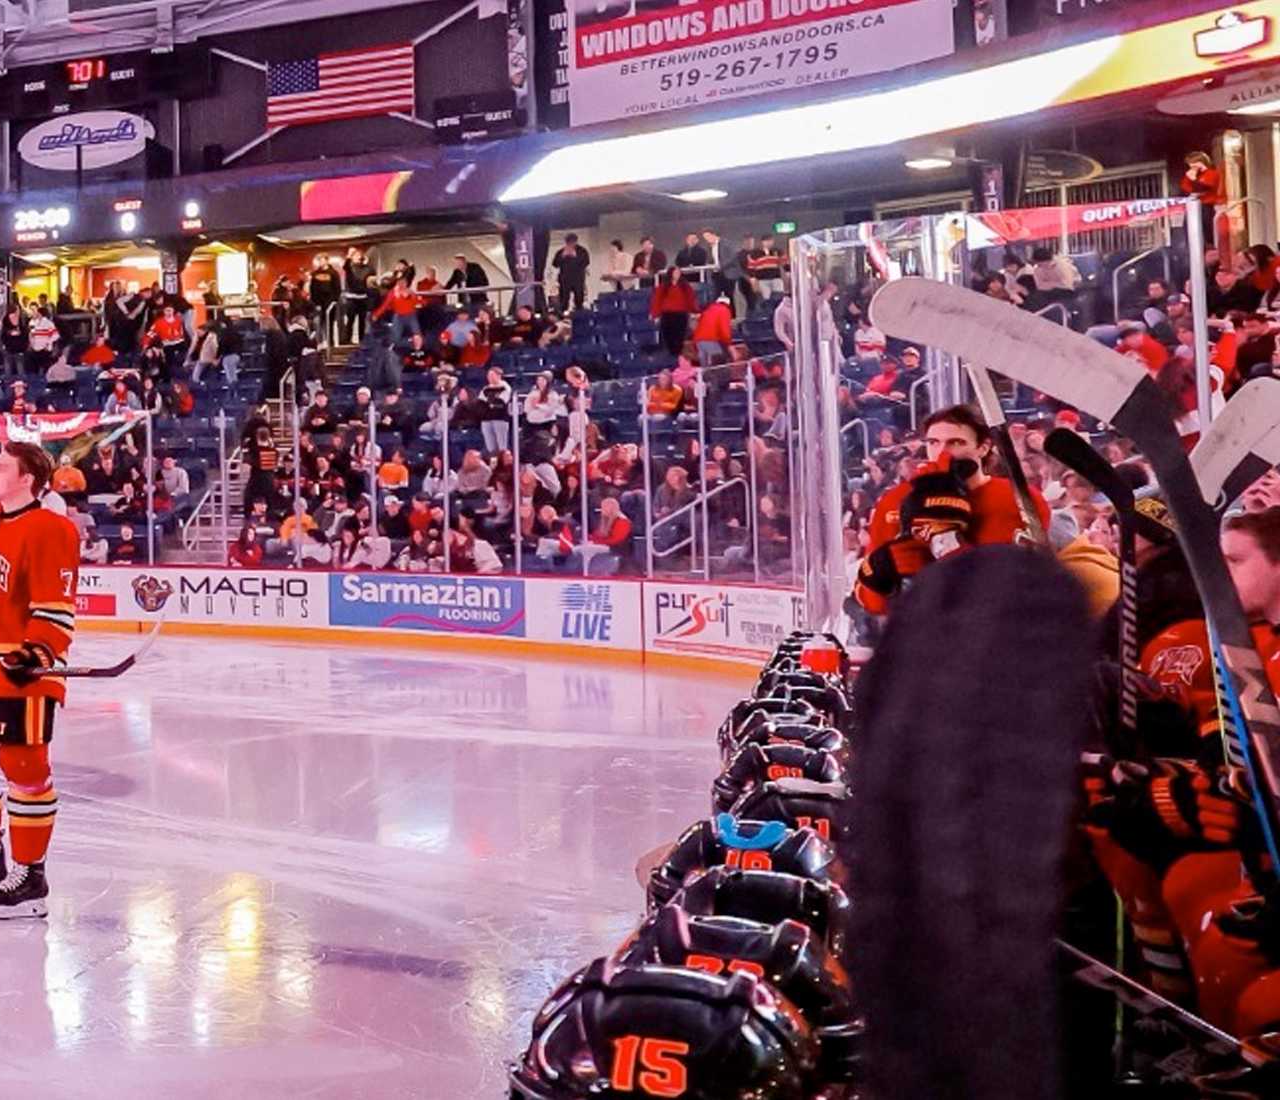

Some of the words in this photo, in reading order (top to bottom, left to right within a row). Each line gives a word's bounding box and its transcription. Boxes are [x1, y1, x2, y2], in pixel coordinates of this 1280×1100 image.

[581, 12, 706, 59] WINDOWS
[712, 0, 766, 34] AND
[620, 13, 885, 76] BETTERWINDOWSANDDOORS.CA
[660, 42, 839, 92] 519-267-1795
[659, 95, 699, 110] LOCAL
[795, 68, 850, 85] DEALER
[59, 568, 73, 597] 7
[180, 575, 308, 598] MACHO
[342, 574, 501, 609] Sarmazian
[180, 595, 309, 618] MOVERS
[438, 608, 501, 623] FLOORING
[561, 612, 613, 642] LIVE
[612, 1034, 690, 1097] 15
